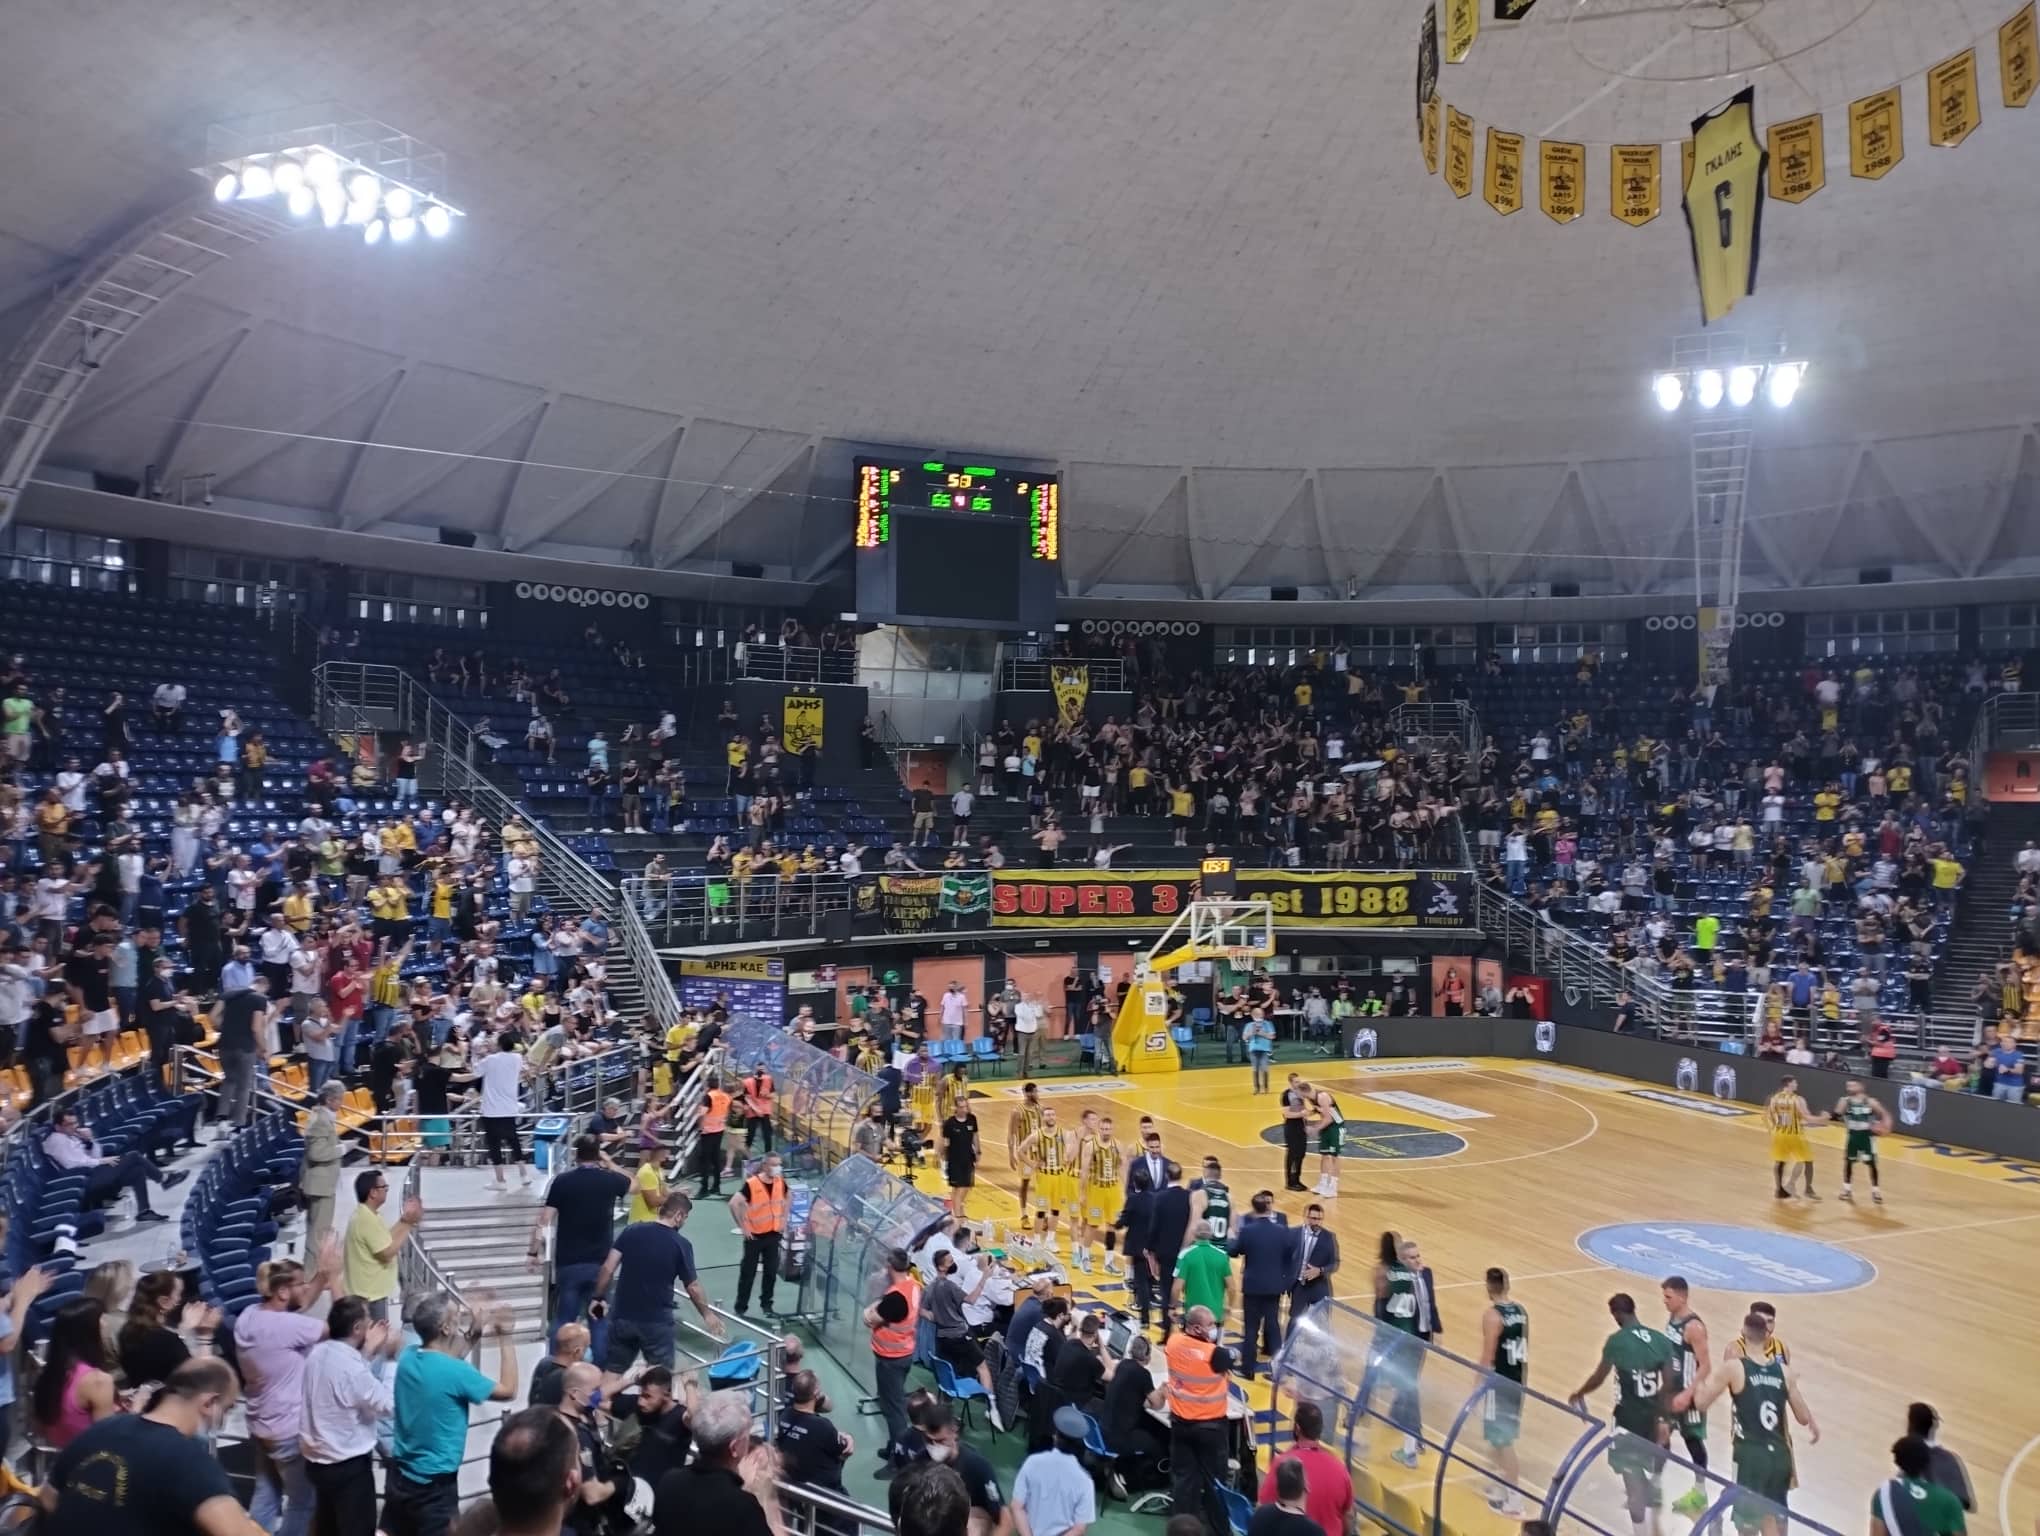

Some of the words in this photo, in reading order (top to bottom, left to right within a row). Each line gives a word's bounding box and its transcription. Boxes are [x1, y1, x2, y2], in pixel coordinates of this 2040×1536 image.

[1705, 142, 1743, 176] ΓΚΑΛΗΣ
[1865, 156, 1891, 173] 1988
[1783, 182, 1812, 195] 1988
[1551, 205, 1575, 216] 1990
[1624, 207, 1650, 217] 1989
[1715, 180, 1732, 248] 6
[1017, 482, 1029, 495] 2
[992, 884, 1135, 914] SUPER
[1152, 884, 1179, 914] 3
[1320, 886, 1410, 915] 1988
[705, 960, 737, 971] ΑΡΗΣ
[740, 962, 764, 973] ΚΑΕ
[1502, 1337, 1529, 1366] 14
[1760, 1400, 1778, 1431] 6
